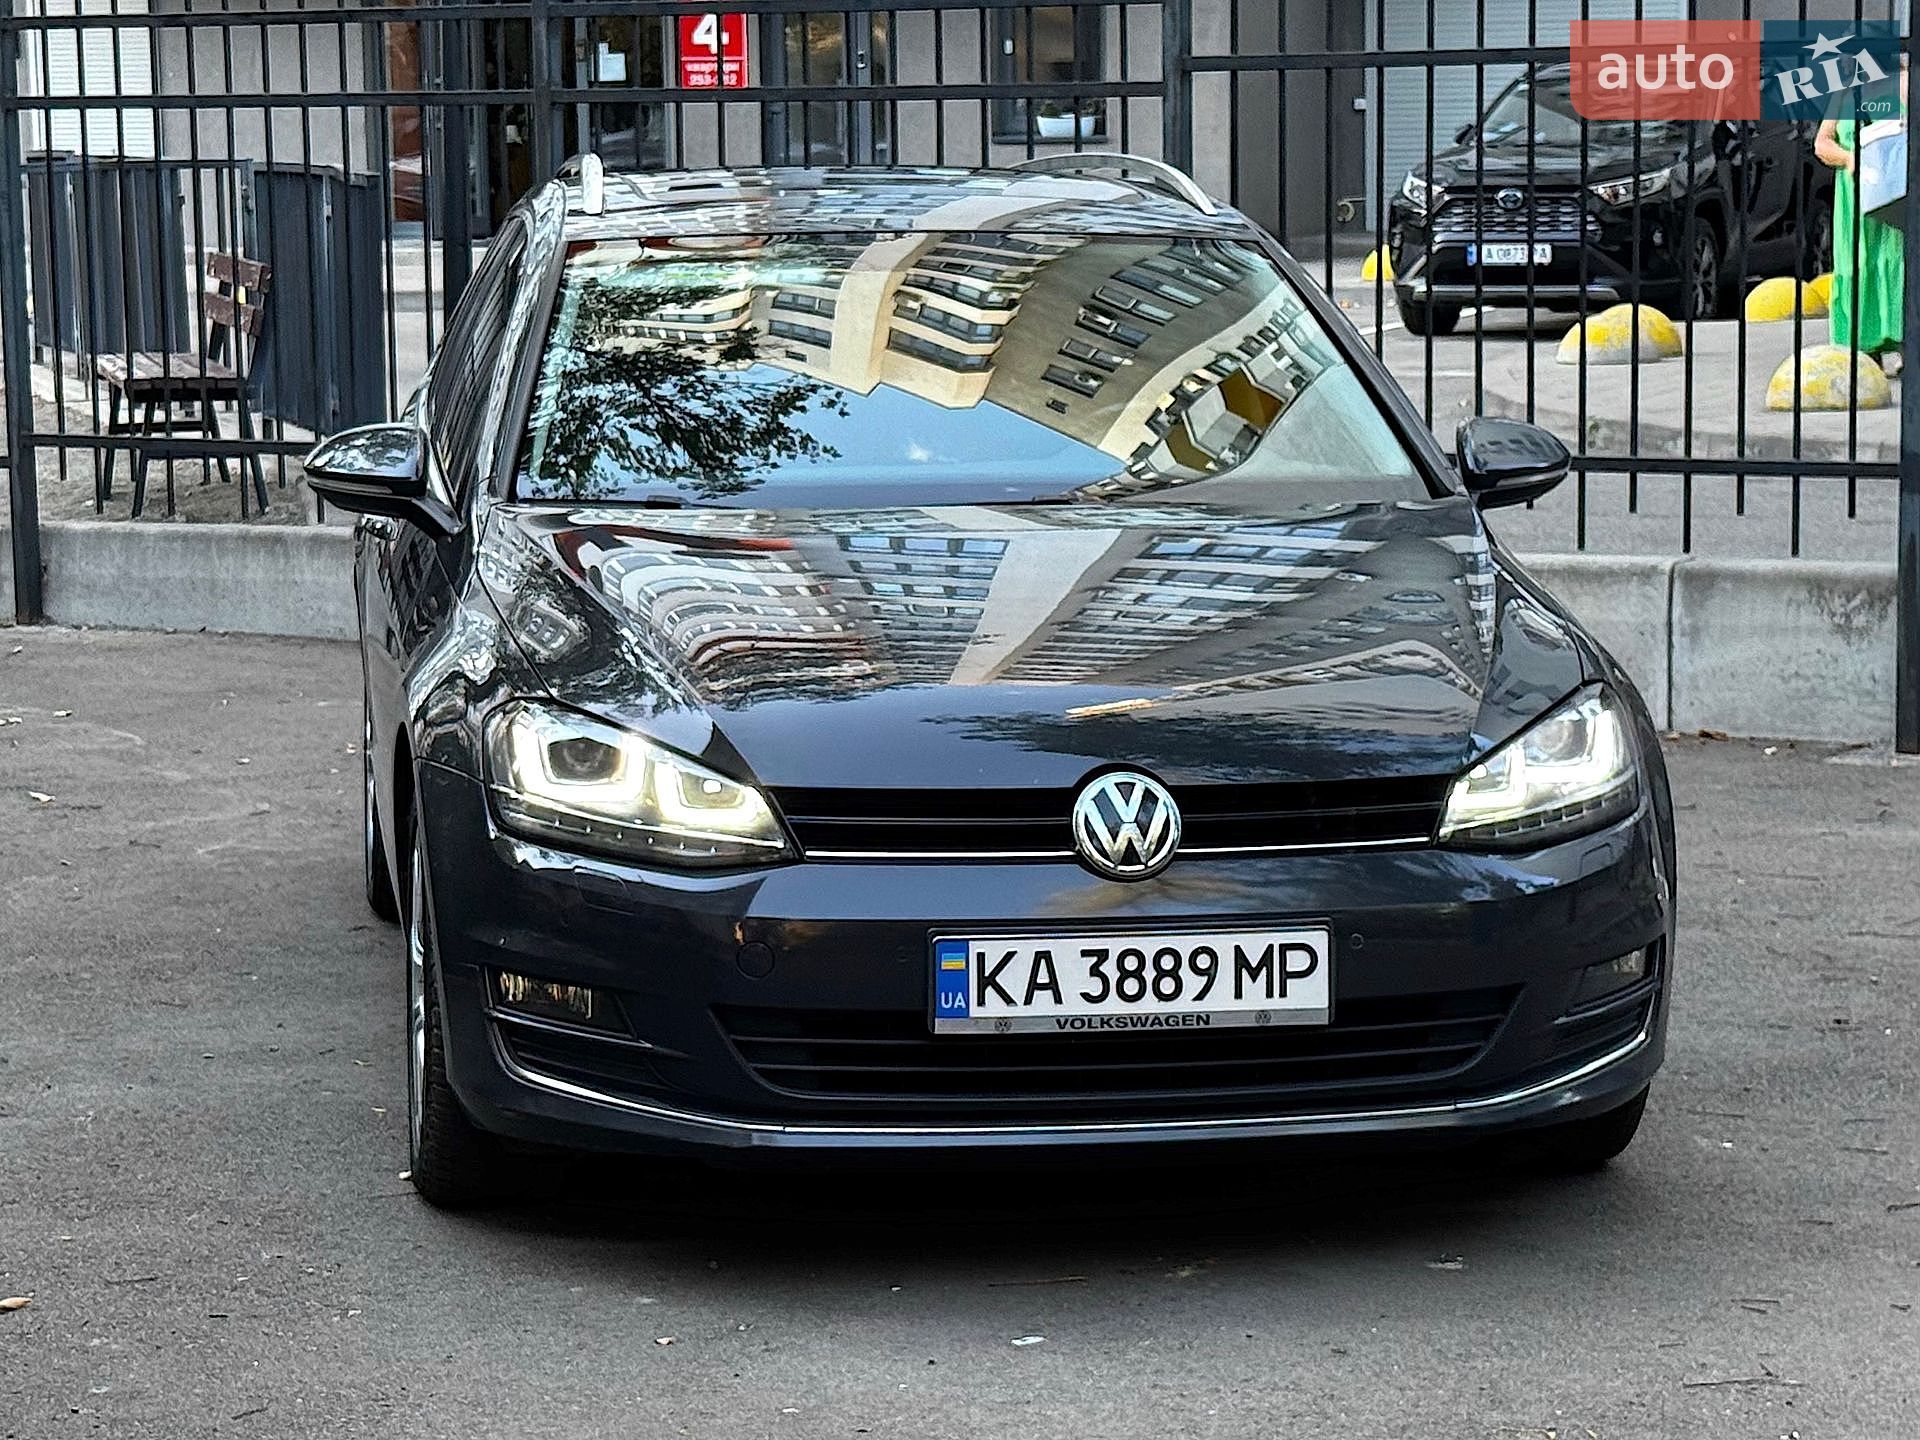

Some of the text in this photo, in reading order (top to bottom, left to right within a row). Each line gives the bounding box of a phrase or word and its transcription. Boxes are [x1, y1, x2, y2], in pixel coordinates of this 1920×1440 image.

[691, 14, 730, 55] 4
[976, 942, 1319, 1007] KA 3889 MP
[941, 991, 967, 1009] UA
[1055, 1014, 1211, 1032] VOLKSWAGEN
